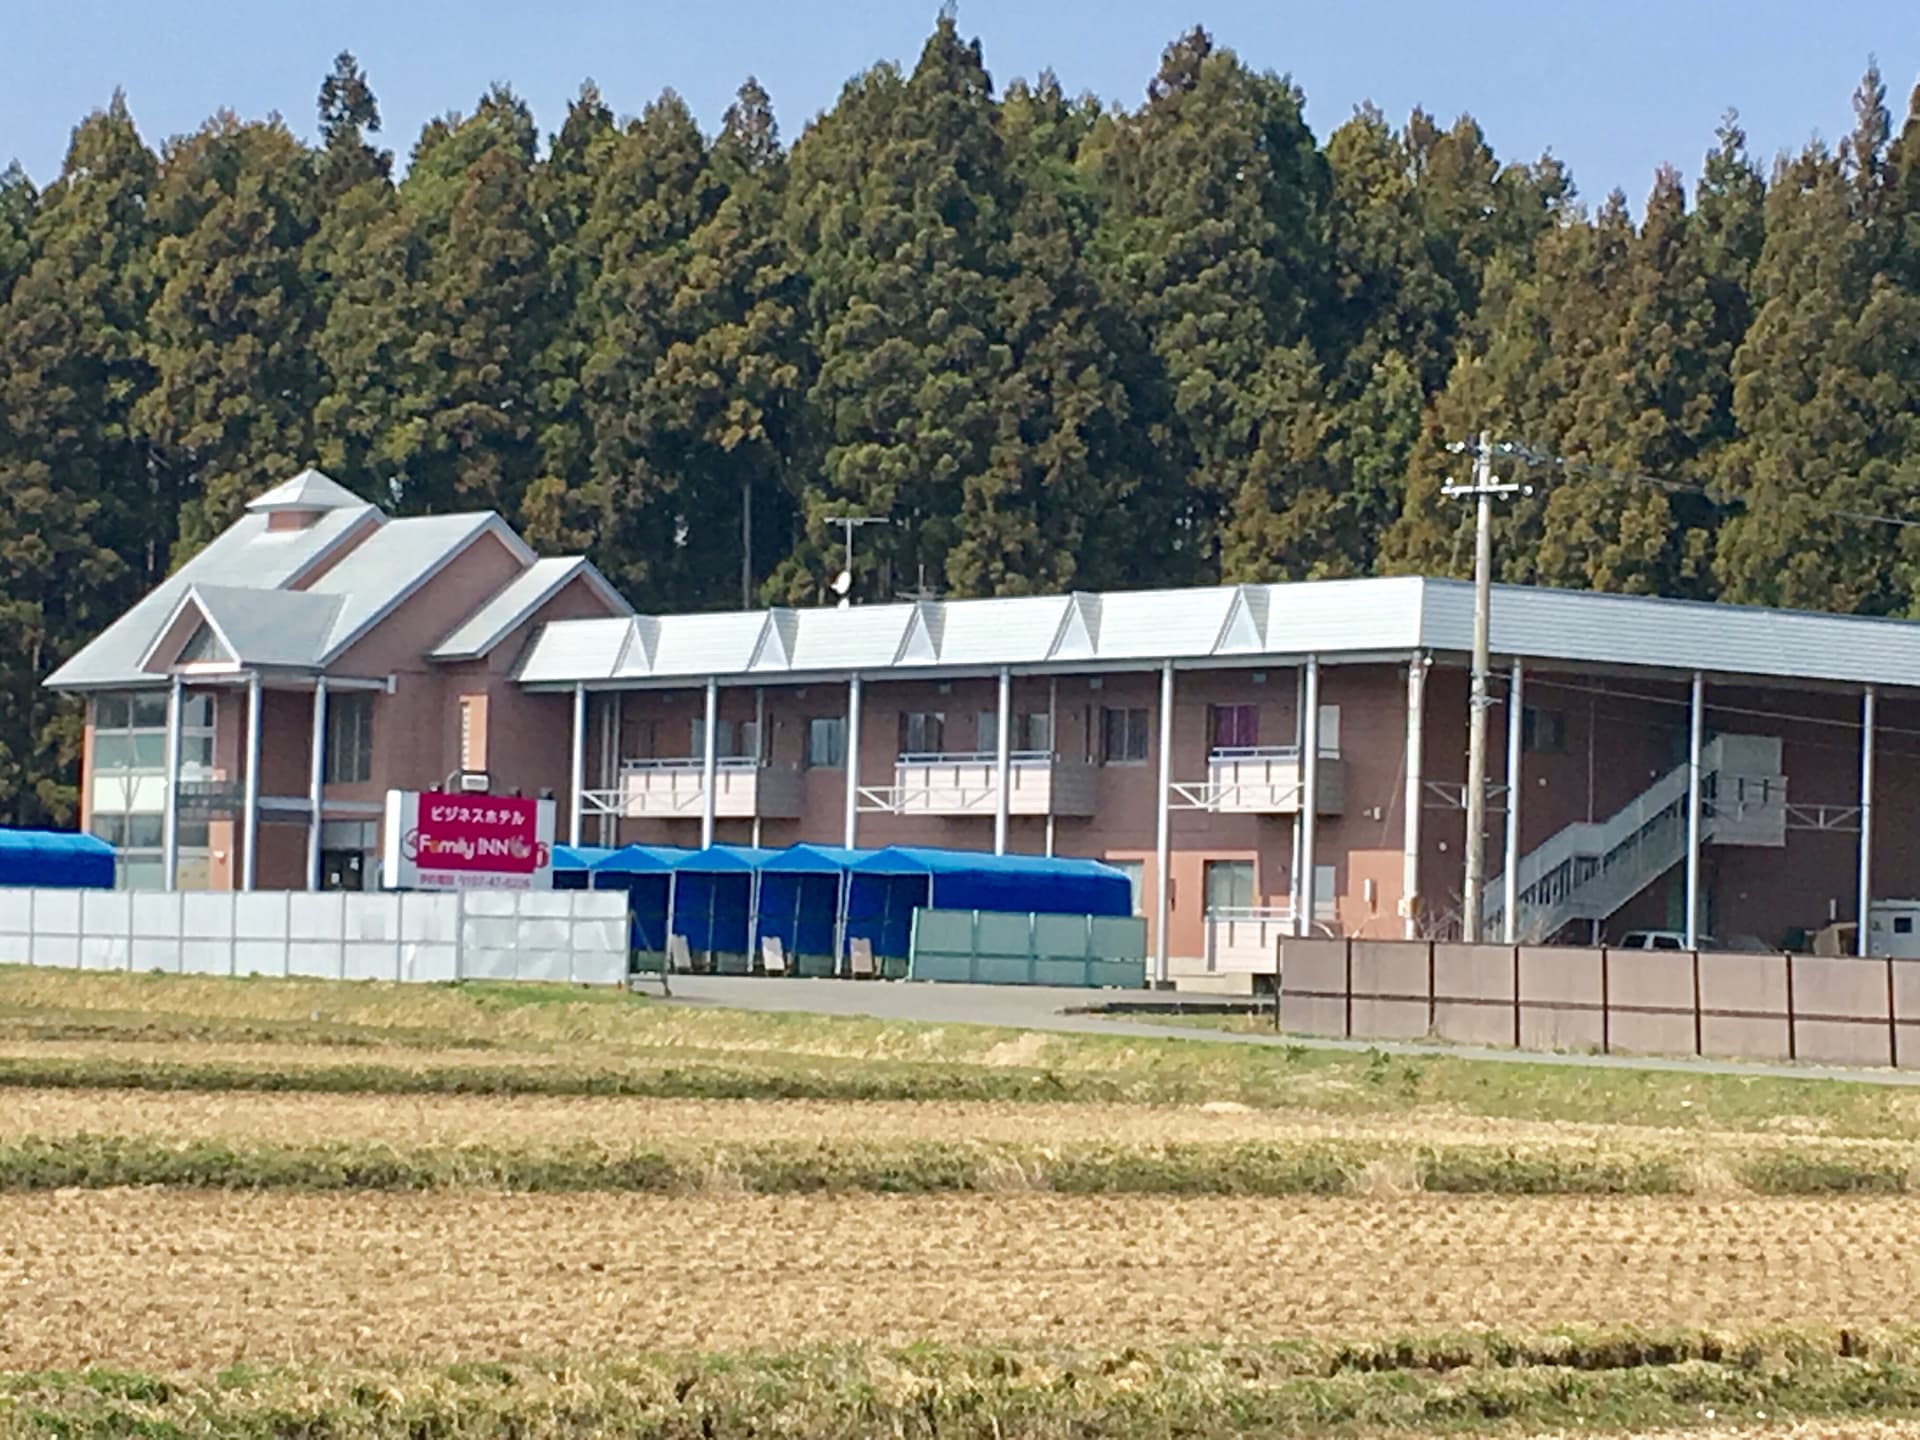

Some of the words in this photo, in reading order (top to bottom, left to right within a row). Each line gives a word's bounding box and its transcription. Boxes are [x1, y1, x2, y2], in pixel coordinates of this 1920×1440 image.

[431, 805, 526, 825] ビジネスホテル
[419, 834, 475, 860] Family
[477, 837, 509, 856] INN
